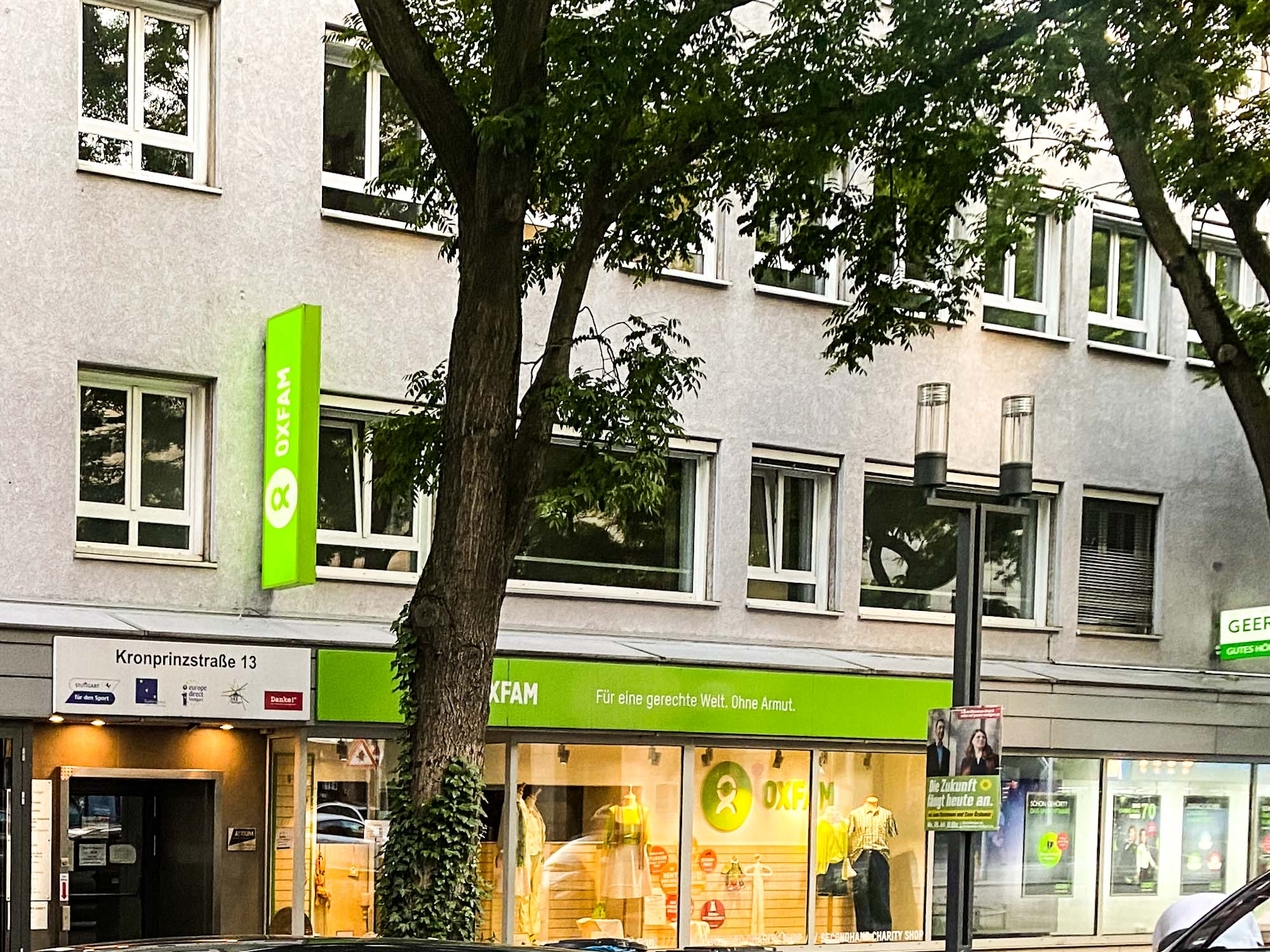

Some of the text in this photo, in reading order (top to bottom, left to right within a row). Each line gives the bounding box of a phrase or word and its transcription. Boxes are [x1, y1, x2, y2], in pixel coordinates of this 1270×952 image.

[275, 367, 291, 457] OXFAM
[115, 649, 257, 669] Kronprinzstraße 13
[1226, 645, 1255, 656] GUTES
[488, 681, 538, 705] XFAM
[596, 689, 796, 711] Für eine gerechte Welt. Ohne Armut.
[928, 778, 977, 793] Die Zukunft
[946, 793, 974, 807] heute
[975, 795, 994, 807] an.
[1141, 802, 1157, 820] 70
[873, 930, 903, 942] CHARITY
[904, 929, 925, 941] SHOP
